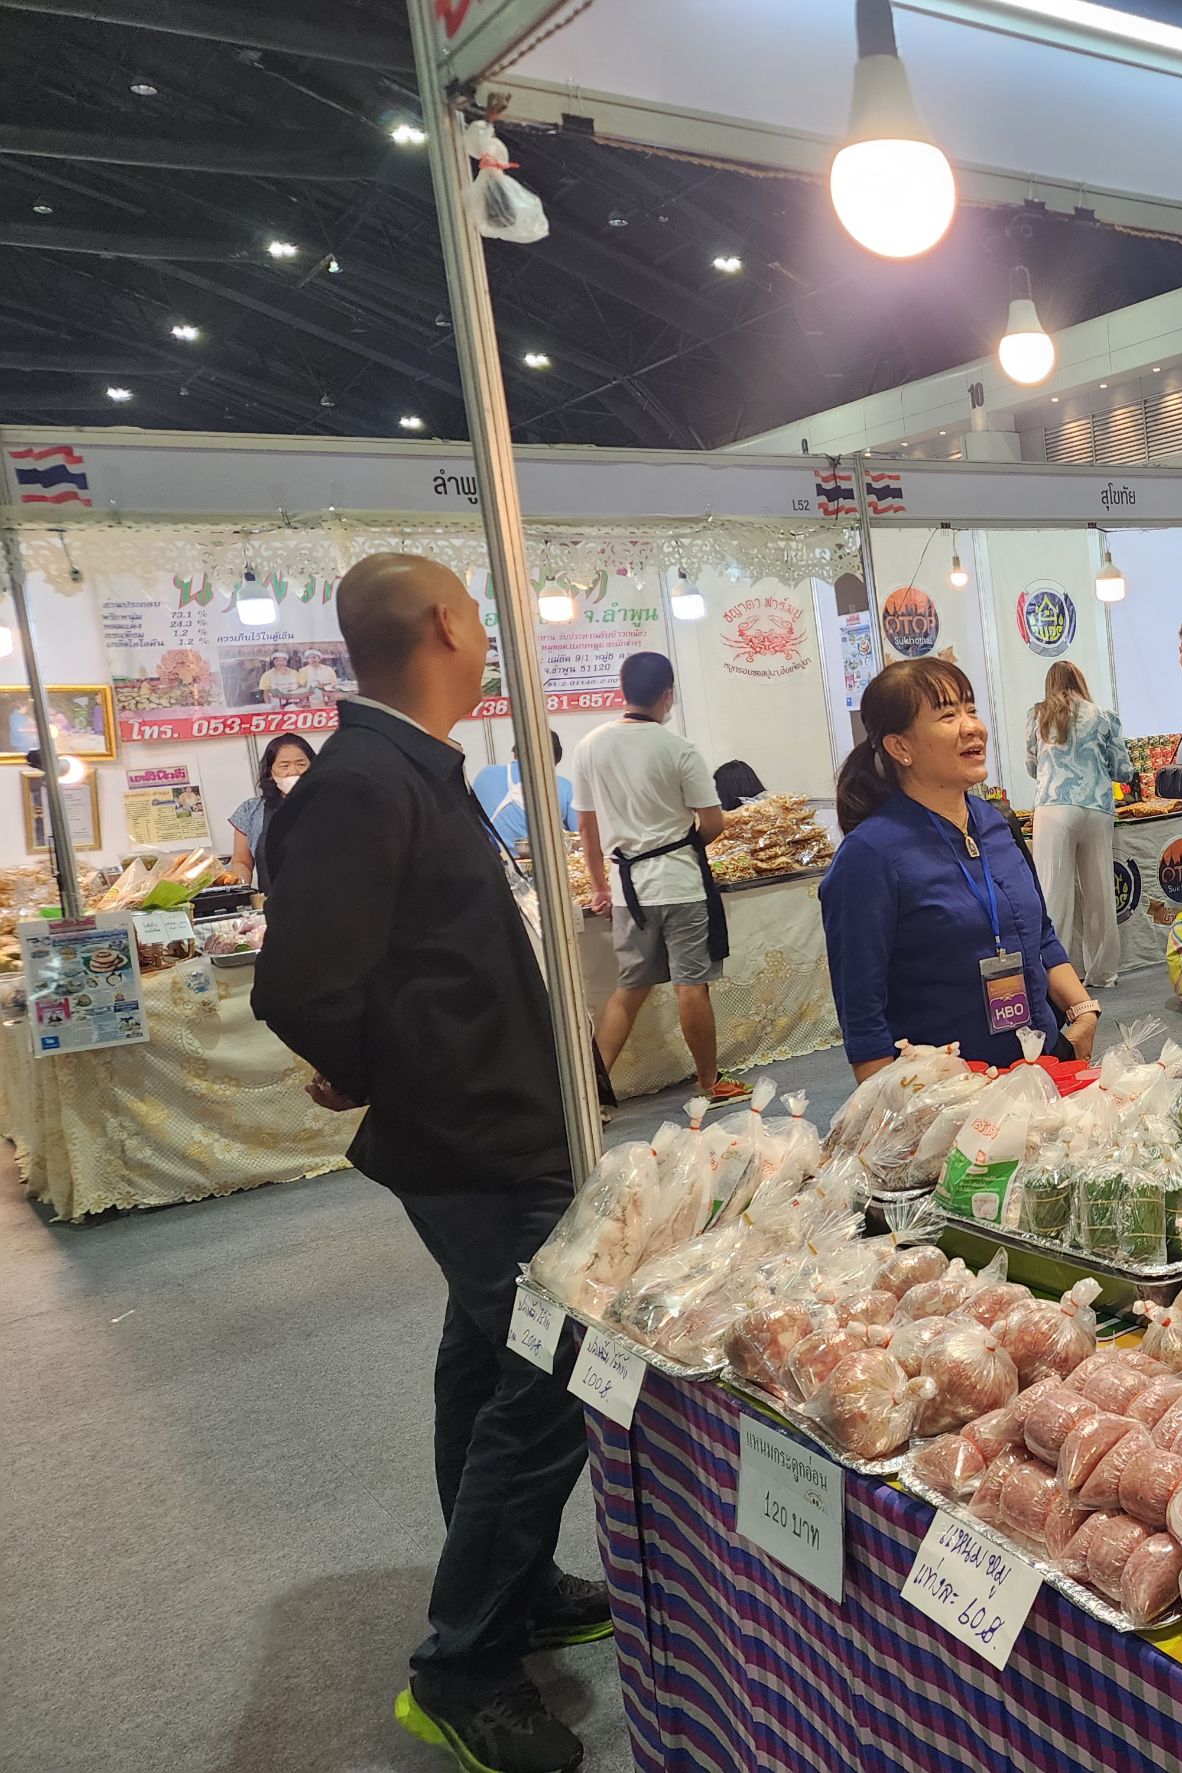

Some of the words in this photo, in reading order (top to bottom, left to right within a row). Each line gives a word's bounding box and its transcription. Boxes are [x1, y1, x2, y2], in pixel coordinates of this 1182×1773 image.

[968, 382, 984, 409] 10
[433, 469, 478, 505] ลำพู
[1101, 482, 1136, 511] สุโขทัย
[792, 499, 810, 511] L52
[584, 602, 658, 627] จ.ลำพูน
[885, 615, 936, 636] OTOP
[547, 691, 627, 710] 81-657-
[129, 719, 179, 740] โทร.
[995, 1003, 1024, 1021] KBO
[746, 1431, 828, 1491] แหนมกระดูกอ่อน
[764, 1489, 788, 1528] 120
[792, 1512, 820, 1551] บาท
